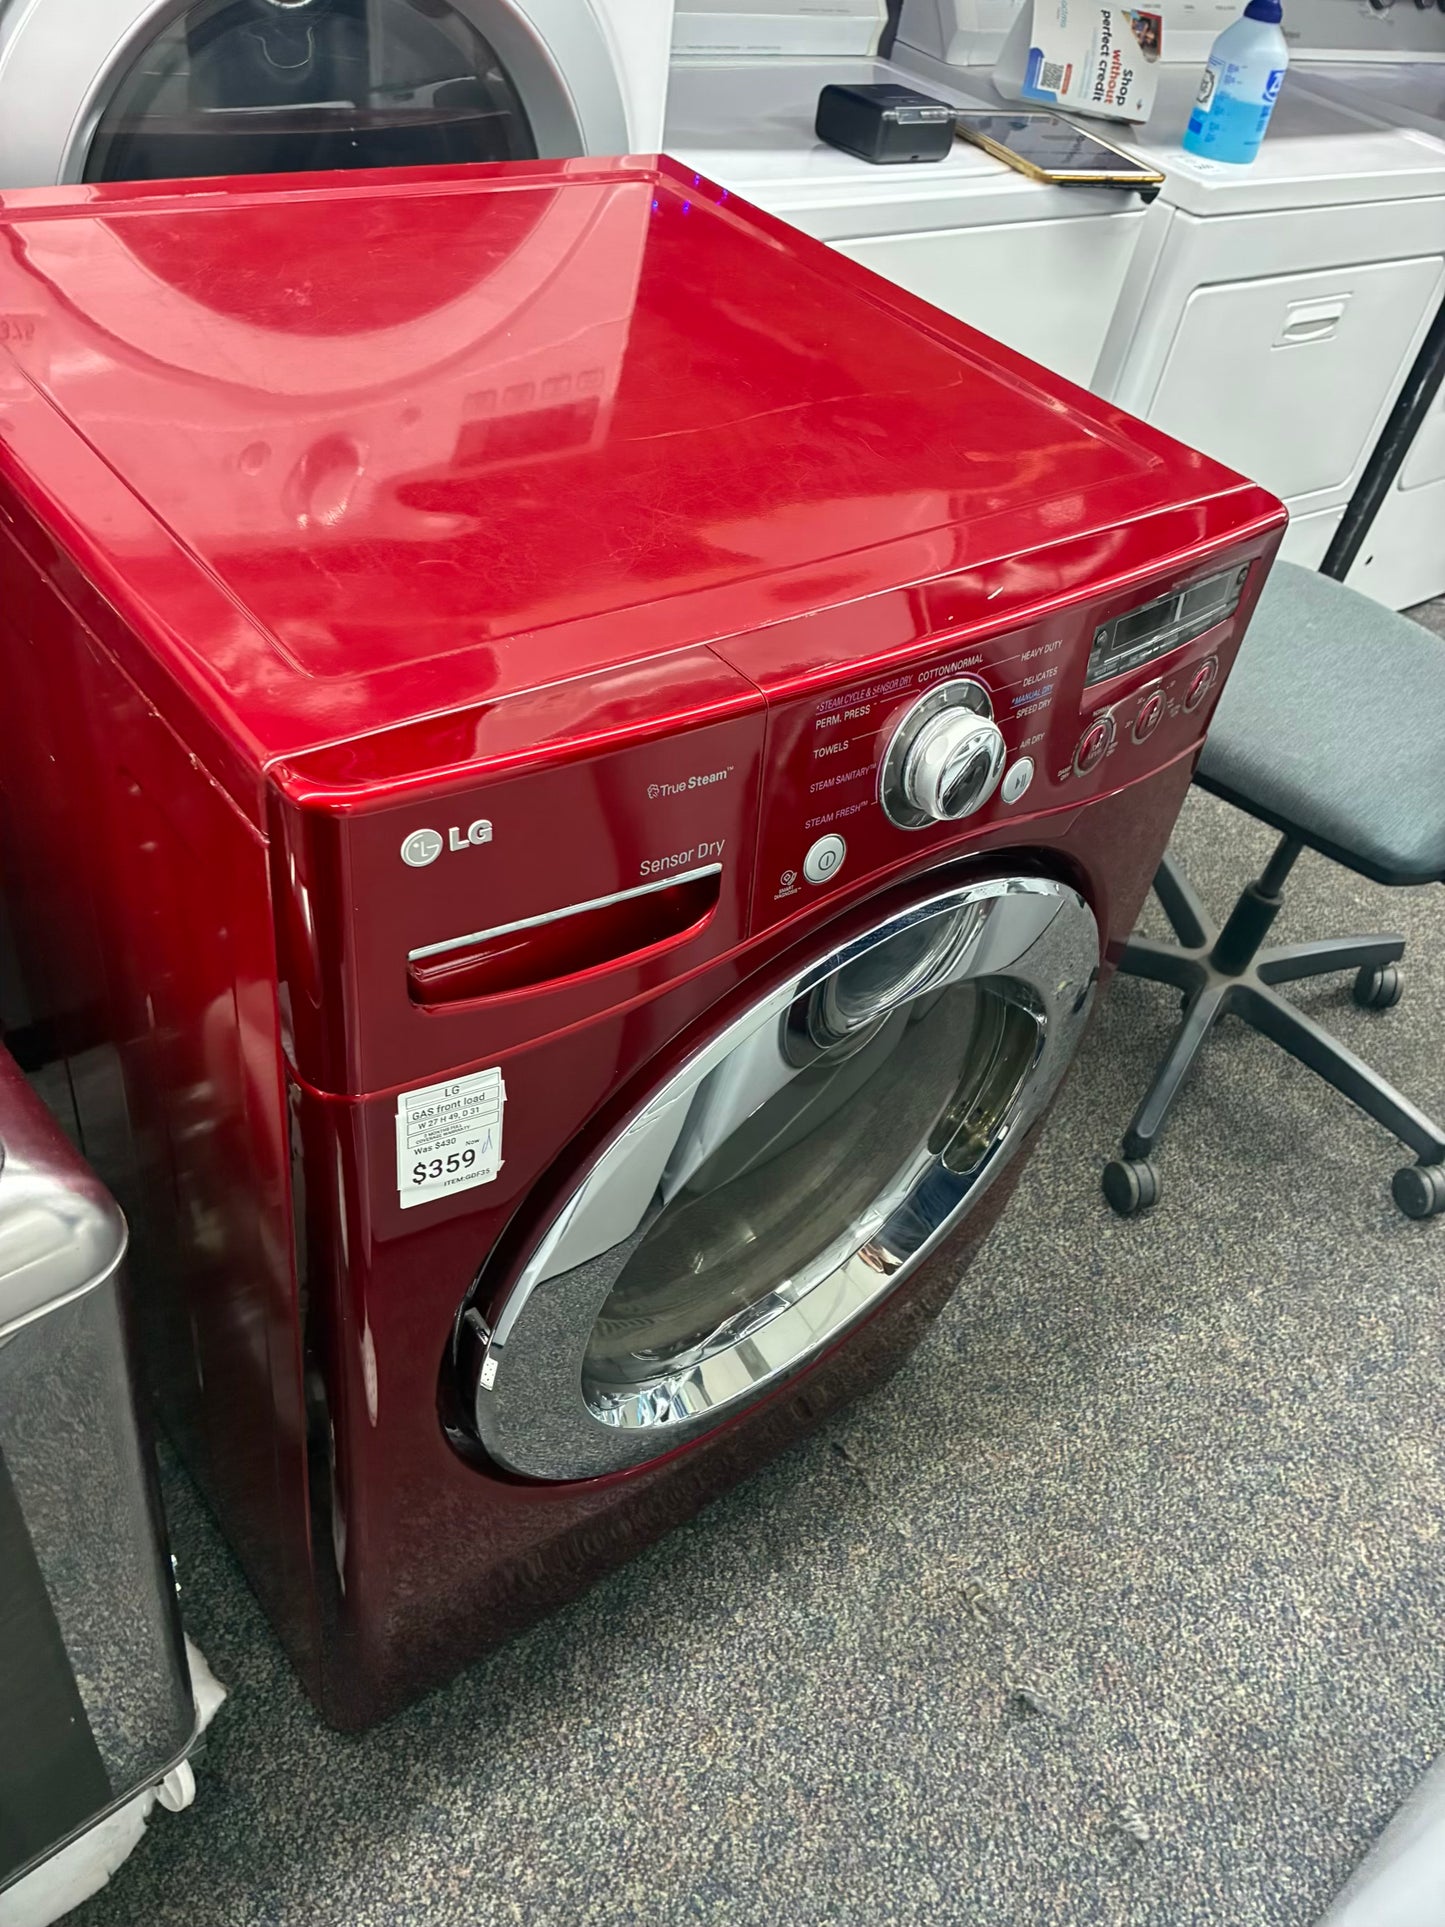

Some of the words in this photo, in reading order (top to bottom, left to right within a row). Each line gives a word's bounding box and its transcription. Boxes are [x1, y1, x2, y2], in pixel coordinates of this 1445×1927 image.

[1100, 9, 1113, 57] perfect
[1092, 60, 1108, 102] credit
[1103, 49, 1122, 105] without
[1116, 68, 1133, 107] Shop
[1020, 646, 1044, 662] HEAVY
[1044, 640, 1063, 654] DUTY
[917, 654, 984, 683] COTTON/NORMAL
[1023, 666, 1058, 687] DELICATES
[844, 690, 865, 704] CYCLE
[872, 681, 899, 696] SENSOR
[898, 675, 913, 689] DRY
[1042, 683, 1055, 694] DRY
[815, 713, 842, 730] PERM.
[844, 704, 871, 722] PRESS
[1016, 704, 1038, 719] SPEED
[1038, 697, 1052, 711] DRY
[813, 739, 849, 759] TOWELS
[1020, 737, 1033, 749] AIR
[1032, 732, 1046, 745] DRY
[809, 777, 835, 793] STEAM
[804, 814, 834, 830] STEAM
[448, 819, 493, 851] LG
[640, 849, 694, 876] Sensor
[697, 839, 726, 859] Dry
[444, 1086, 460, 1097] LG
[412, 1107, 434, 1121] GAS
[436, 1101, 461, 1114] front
[464, 1093, 485, 1105] load
[418, 1121, 427, 1130] W
[428, 1118, 438, 1127] 27
[440, 1115, 447, 1123] H
[448, 1112, 461, 1121] 49,
[462, 1109, 469, 1117] D
[469, 1107, 480, 1115] 31
[413, 1145, 433, 1155] Was
[435, 1137, 457, 1150] $430
[465, 1138, 480, 1147] Now
[412, 1148, 476, 1185] $359
